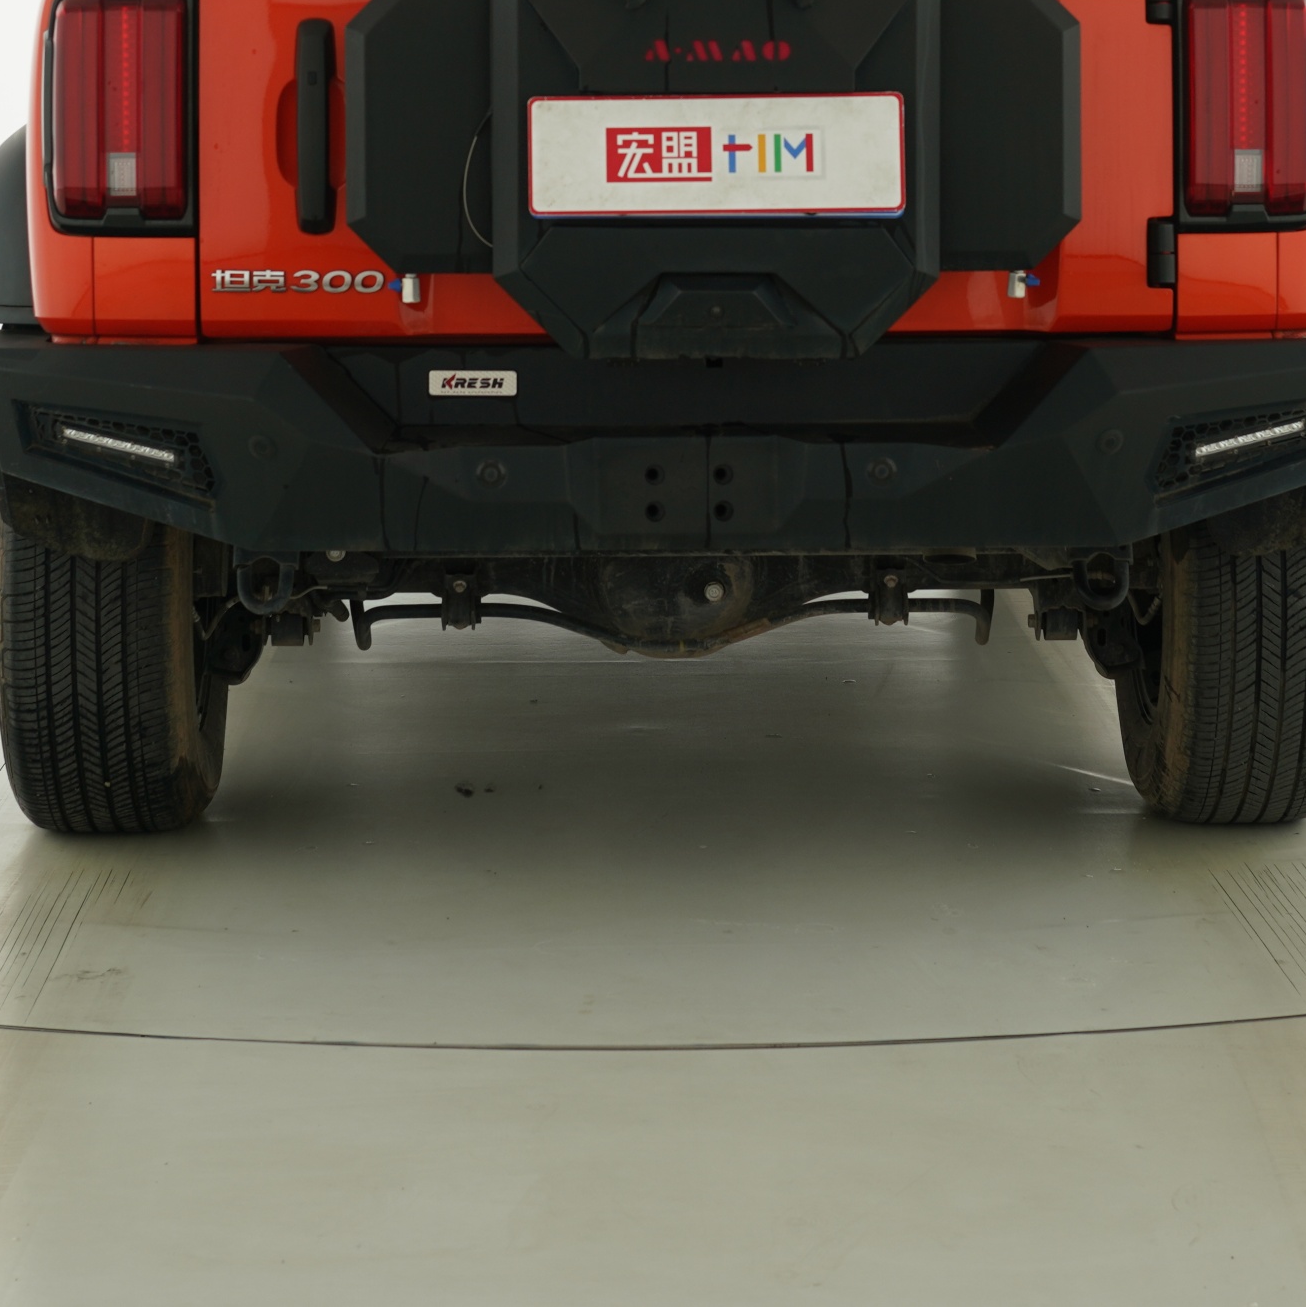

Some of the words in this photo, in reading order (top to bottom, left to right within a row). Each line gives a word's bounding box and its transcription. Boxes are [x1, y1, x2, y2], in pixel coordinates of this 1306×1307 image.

[616, 131, 712, 178] 宏盟
[211, 269, 384, 293] 坦克300
[441, 374, 504, 390] KRESH
